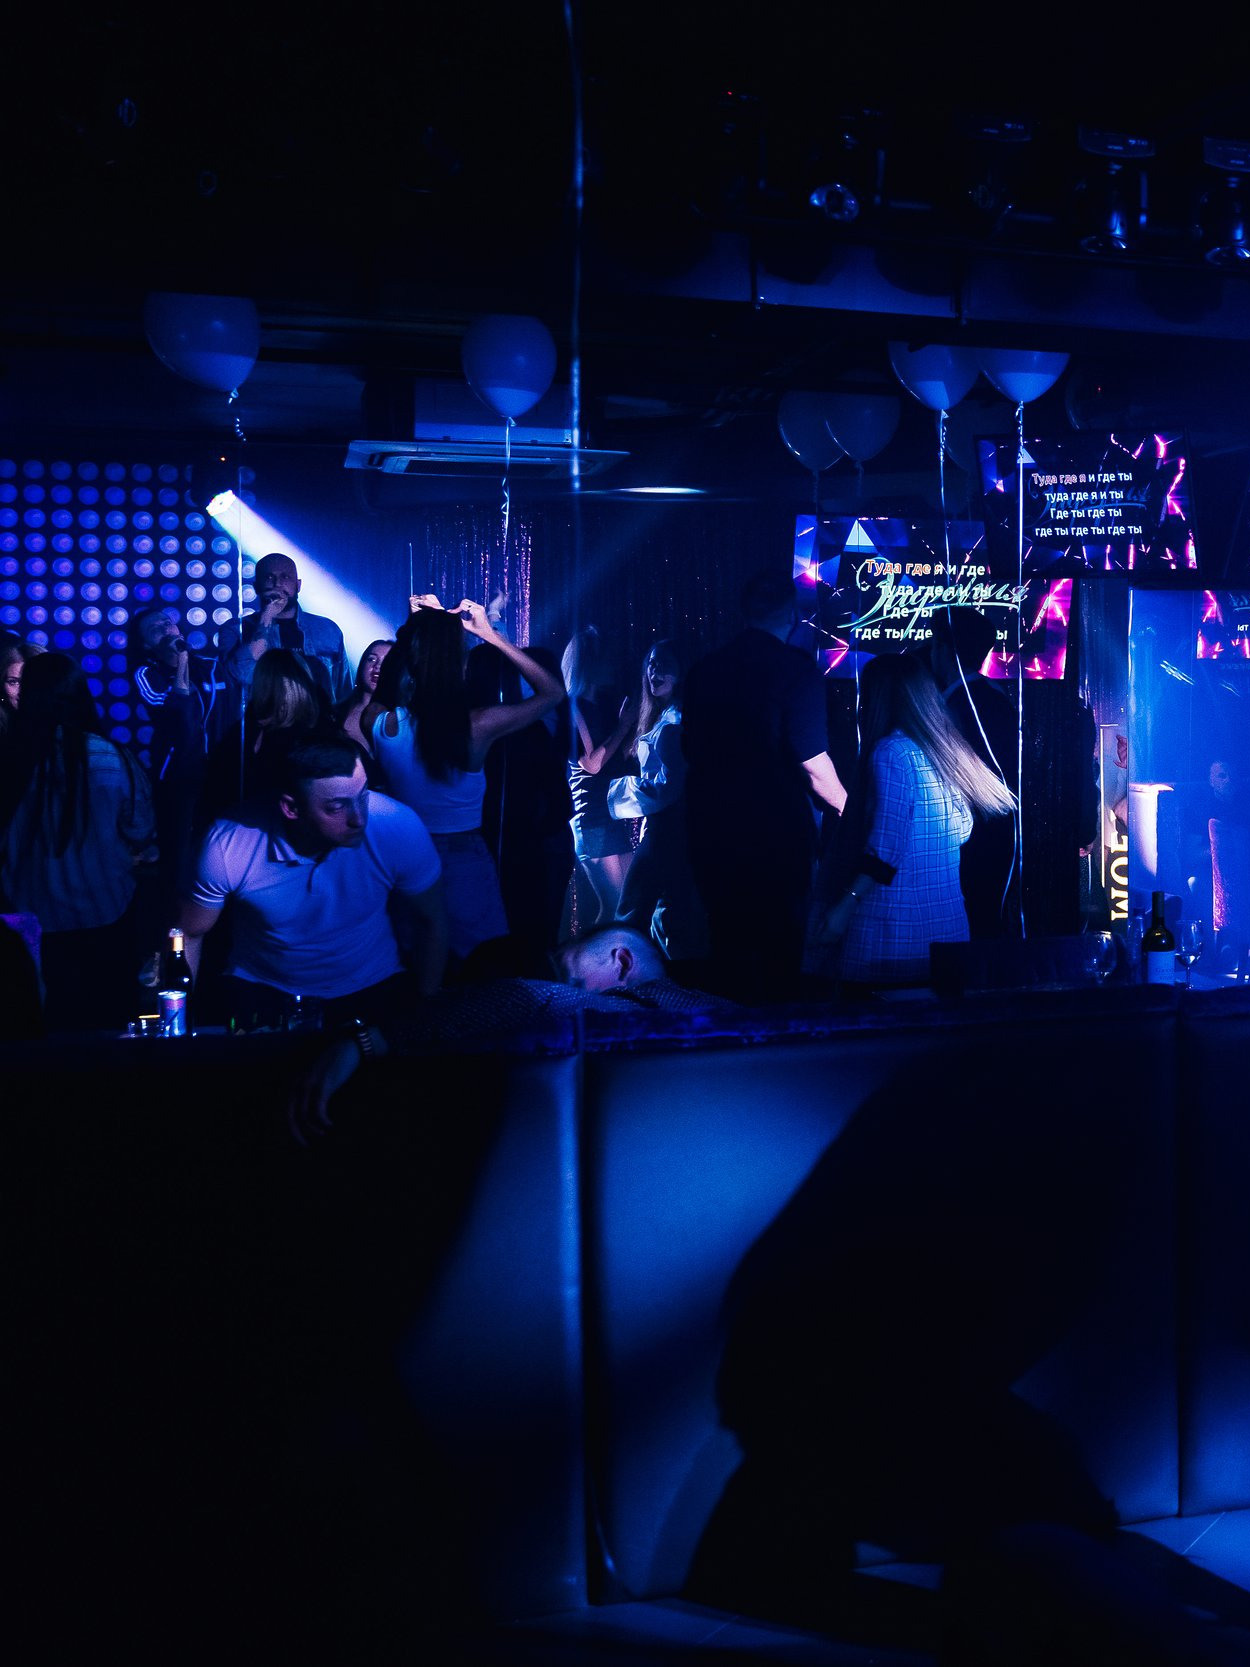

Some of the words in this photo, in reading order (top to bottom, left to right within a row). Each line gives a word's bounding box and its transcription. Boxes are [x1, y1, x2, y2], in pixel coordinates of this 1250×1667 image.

[1032, 473, 1058, 487] Туда
[1060, 474, 1077, 484] где
[1088, 474, 1095, 482] и
[1098, 473, 1115, 483] где
[1118, 473, 1132, 481] ты
[1045, 492, 1068, 503] туда
[1071, 492, 1088, 501] где
[1090, 492, 1097, 500] я
[1109, 491, 1123, 499] ты
[1050, 508, 1068, 519] Где
[1071, 510, 1084, 518] ты
[1088, 509, 1105, 518] где
[1108, 509, 1122, 517] ты
[1035, 528, 1052, 537] где
[1055, 528, 1068, 536] ты
[1071, 527, 1088, 537] где
[1091, 527, 1105, 535] ты
[1108, 526, 1125, 536] где
[1128, 526, 1142, 534] ты
[866, 559, 901, 576] Туда
[906, 563, 931, 576] где
[934, 564, 943, 575] я
[949, 564, 957, 575] и
[960, 564, 985, 577] где
[880, 585, 914, 599] туда
[919, 585, 944, 598] где
[973, 586, 991, 598] ты
[883, 605, 909, 619] Где
[914, 607, 932, 618] ты
[856, 628, 880, 640] где
[885, 628, 904, 639] ты
[908, 628, 933, 640] где
[996, 630, 1008, 640] ы
